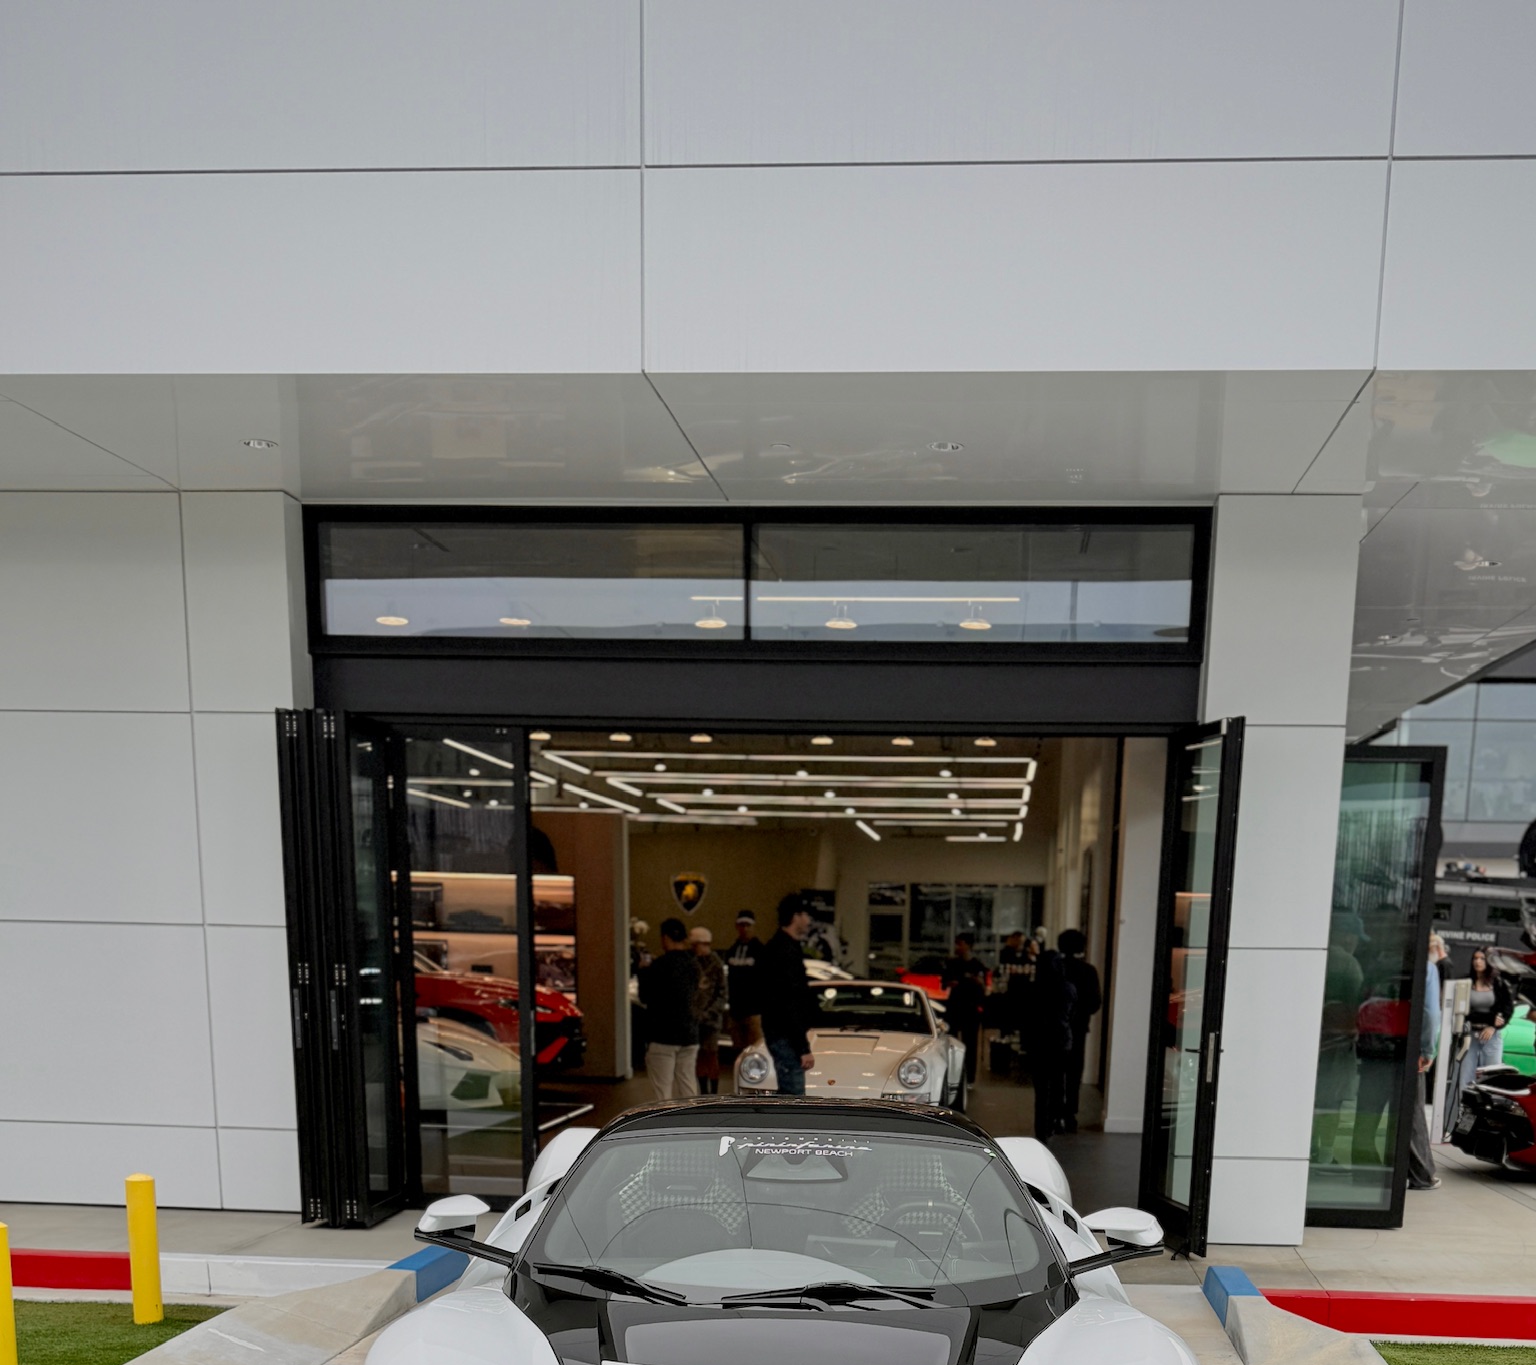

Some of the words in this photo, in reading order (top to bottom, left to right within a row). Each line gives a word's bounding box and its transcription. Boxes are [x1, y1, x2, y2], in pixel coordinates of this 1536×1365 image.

[1466, 932, 1495, 942] POLICE
[755, 1148, 812, 1156] NEWPORT
[815, 1149, 853, 1157] BEACH
